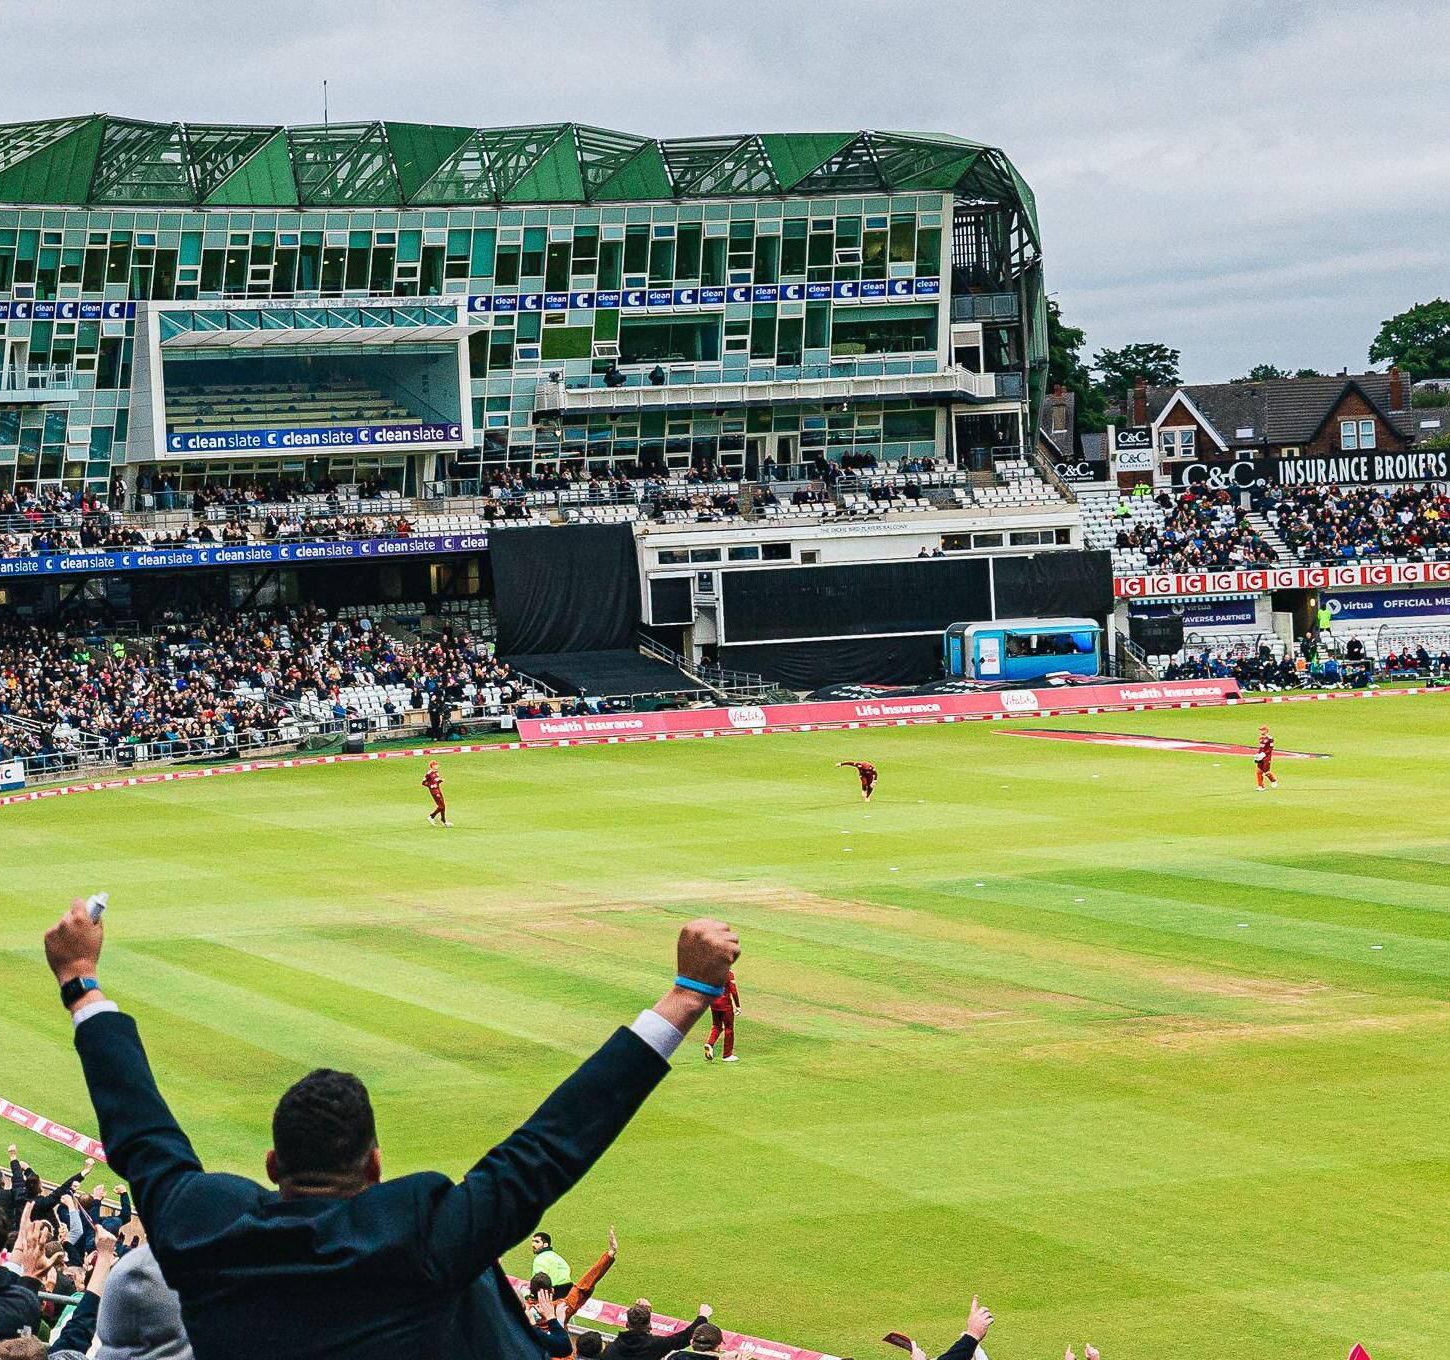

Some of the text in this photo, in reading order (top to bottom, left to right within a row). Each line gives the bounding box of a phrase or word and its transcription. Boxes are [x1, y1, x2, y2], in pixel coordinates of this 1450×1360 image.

[702, 289, 723, 297] clean
[82, 304, 100, 312] clean
[188, 435, 226, 448] clean
[228, 434, 260, 448] slate
[283, 432, 320, 445] clean
[322, 430, 353, 444] slate
[375, 427, 411, 441] clean
[413, 426, 444, 440] slate
[1279, 457, 1368, 484] INSURANCE
[1375, 452, 1447, 480] BROKERS
[15, 560, 38, 572] slate
[60, 558, 88, 569] clean
[90, 556, 114, 568] slate
[138, 554, 166, 566] clean
[168, 552, 193, 564] slate
[216, 550, 244, 561] clean
[246, 548, 272, 560] slate
[296, 545, 326, 556] clean
[327, 542, 352, 555] slate
[378, 541, 408, 552] clean
[410, 539, 435, 551] slate
[1120, 563, 1450, 595] IG IG IG IG IG IG IG IG IG IG IG
[1343, 601, 1373, 610] virtua
[1384, 599, 1432, 608] OFFICIAL
[1120, 687, 1222, 700] Health insurance
[855, 703, 940, 716] Life insurance
[540, 721, 583, 733] Health
